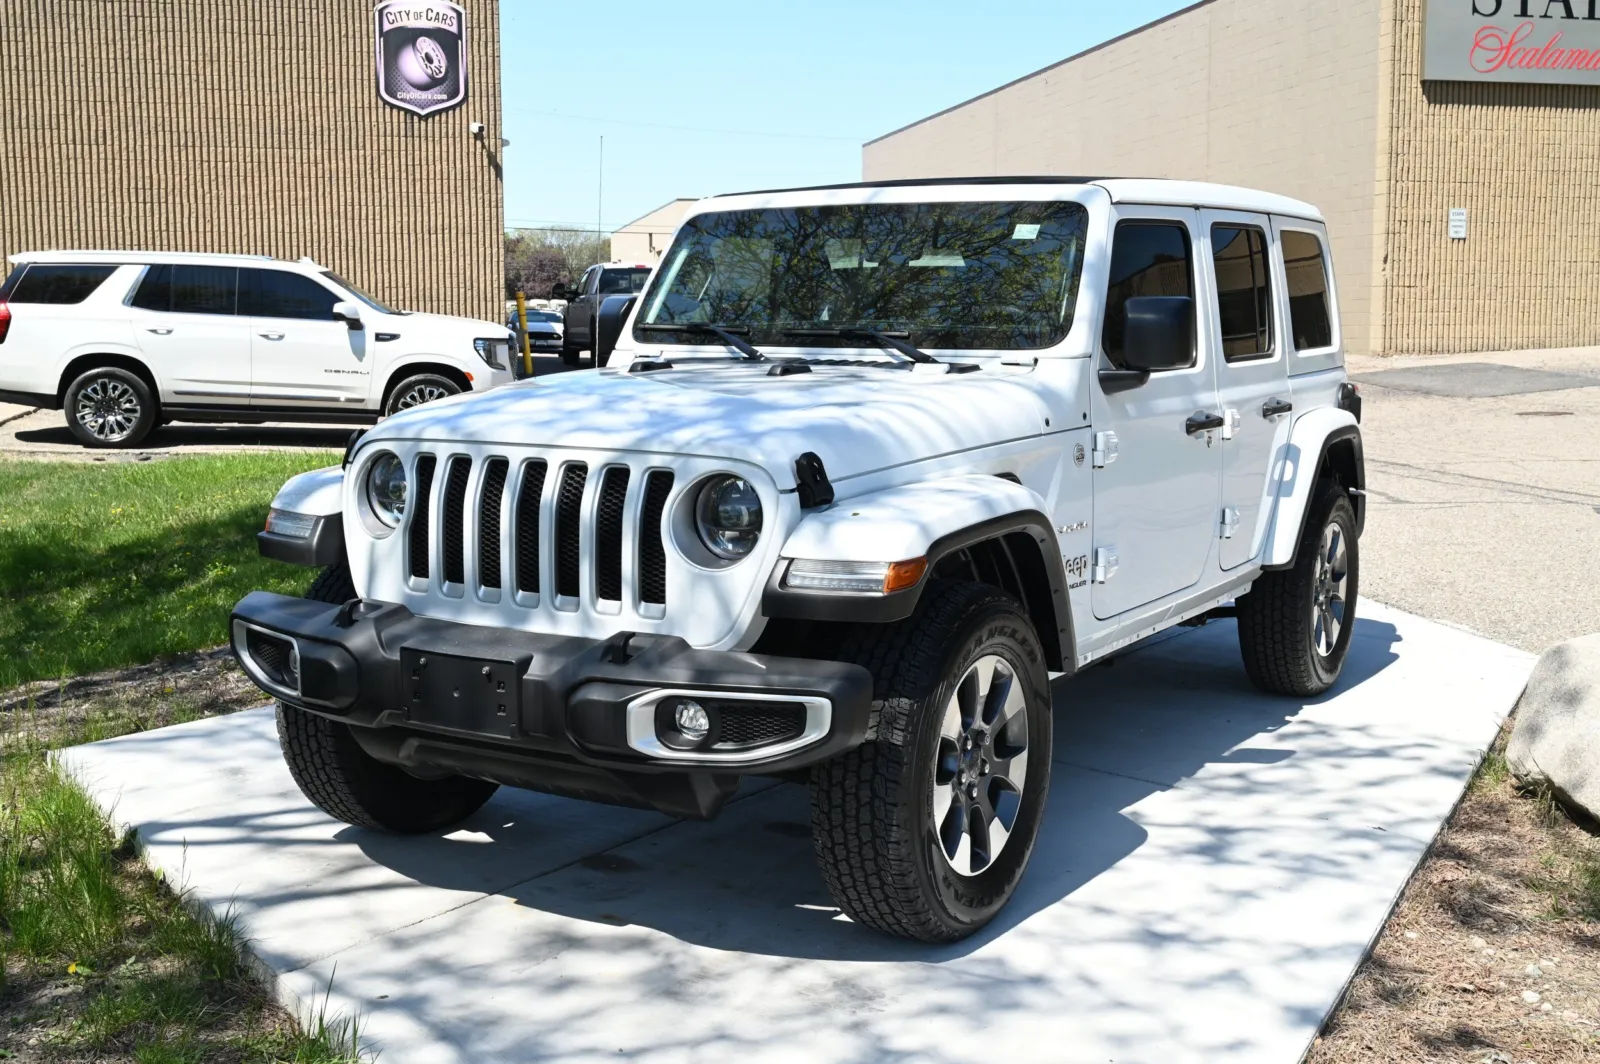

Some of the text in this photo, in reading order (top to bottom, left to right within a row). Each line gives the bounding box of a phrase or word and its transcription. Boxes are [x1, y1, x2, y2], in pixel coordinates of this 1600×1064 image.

[385, 7, 456, 27] CITY OF CARS
[397, 91, 448, 100] CityOfCars.com
[1063, 554, 1087, 578] eep
[1068, 579, 1087, 590] NGLER
